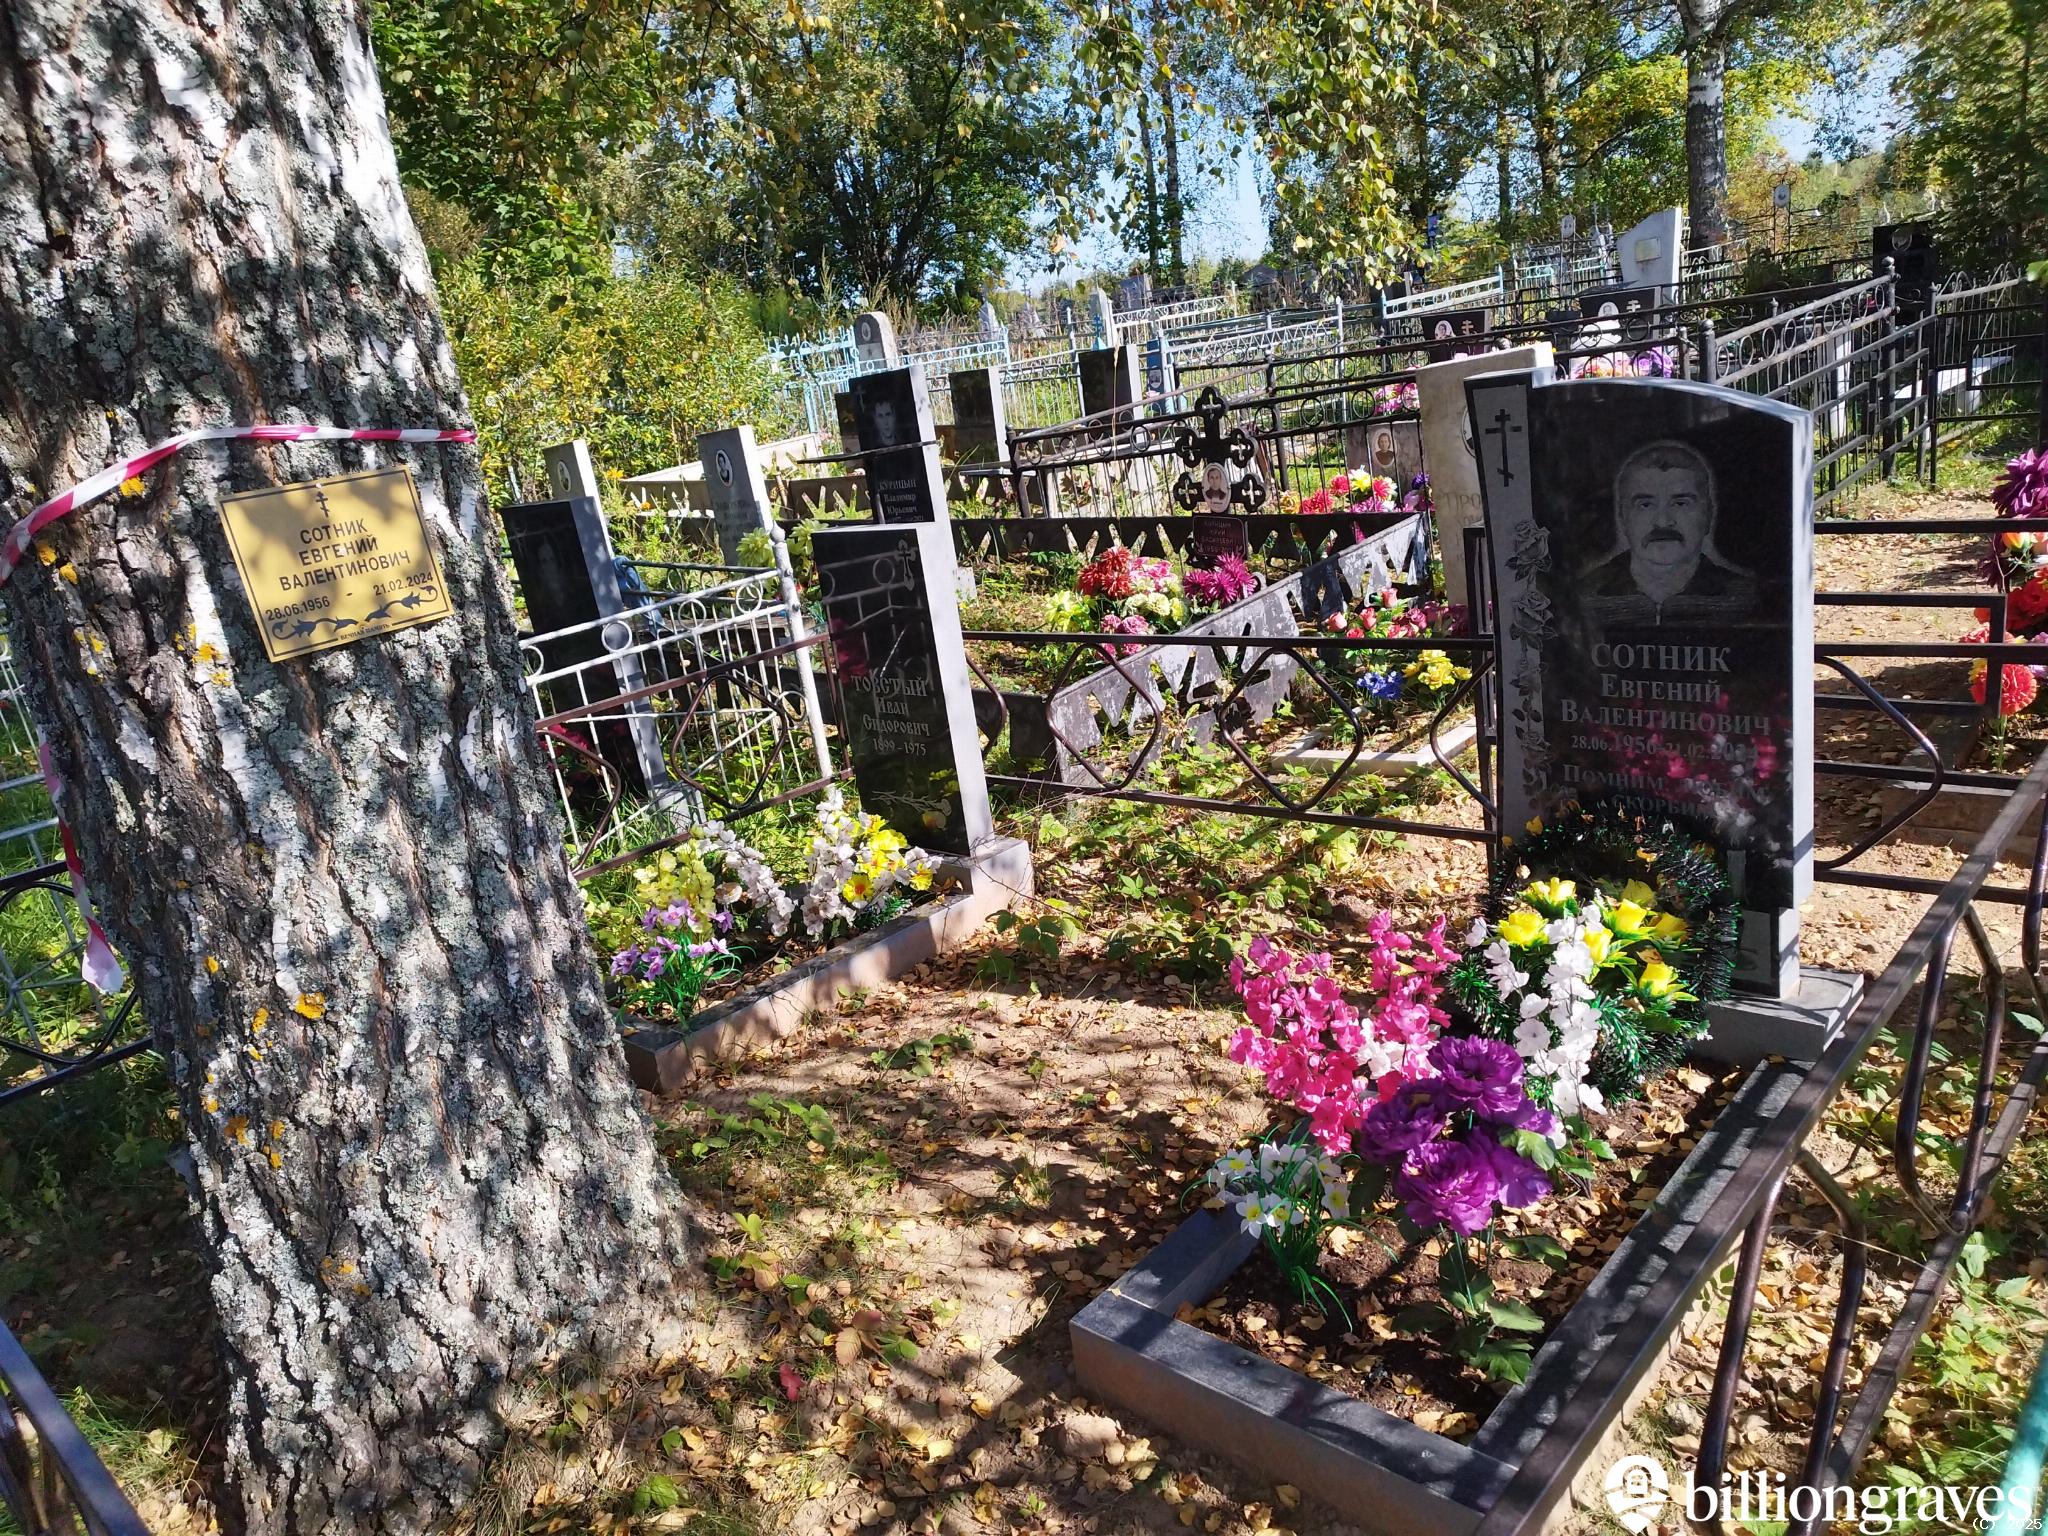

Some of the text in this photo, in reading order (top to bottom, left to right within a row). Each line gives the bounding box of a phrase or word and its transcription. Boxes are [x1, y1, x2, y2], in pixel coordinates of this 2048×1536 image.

[300, 518, 368, 544] СОТНИК
[298, 534, 379, 566] ЕВГЕНИЙ
[279, 551, 411, 591] ВАЛЕНТИНОВИЧ
[265, 595, 330, 622] 28.06.1956
[373, 572, 434, 596] 21.02.2024
[1591, 643, 1731, 673] СОТНИК
[851, 674, 929, 697] ТОВСТЫЙ
[874, 738, 896, 751] 1899
[904, 742, 927, 756] 1975
